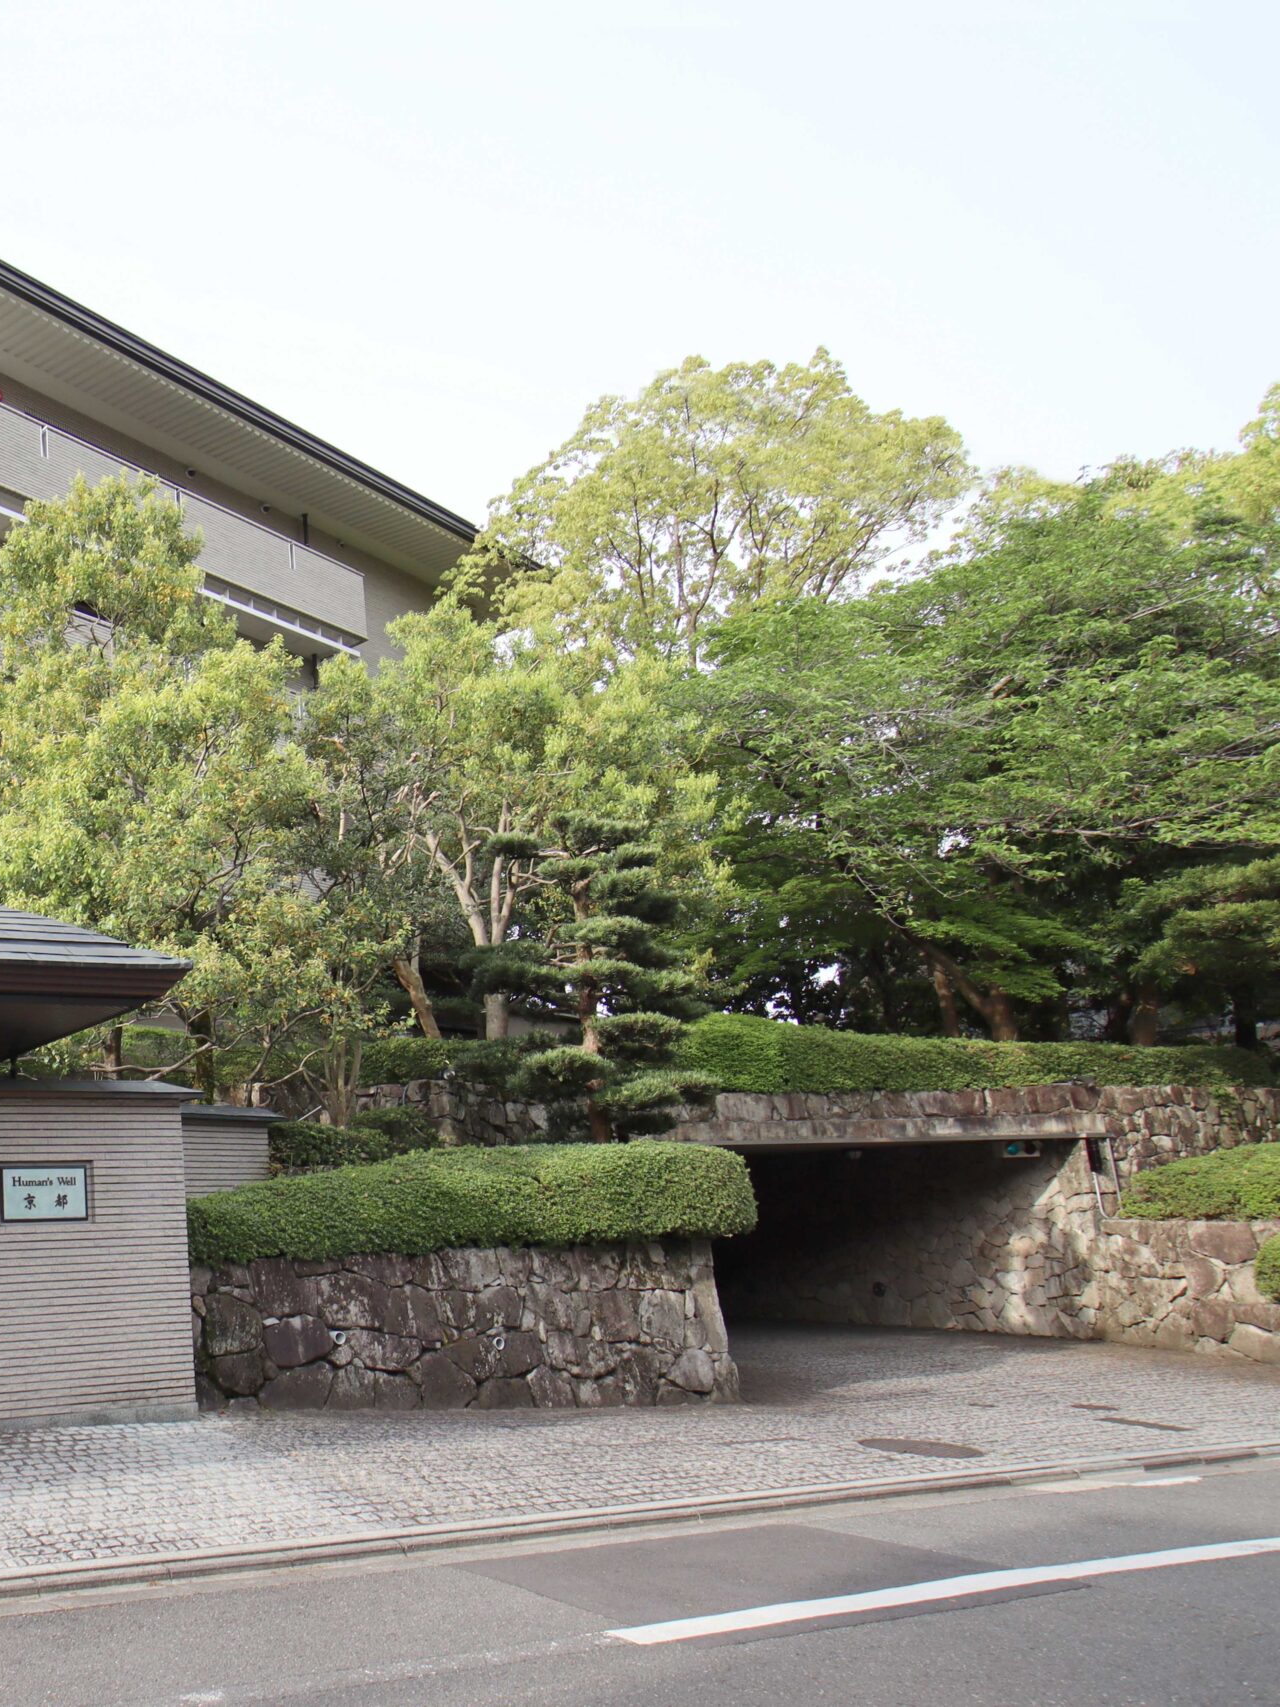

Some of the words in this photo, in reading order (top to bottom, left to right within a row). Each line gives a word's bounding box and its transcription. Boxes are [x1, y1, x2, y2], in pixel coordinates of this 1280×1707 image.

[12, 1176, 54, 1187] Human's
[57, 1176, 77, 1186] Well
[24, 1193, 68, 1210] 京都
